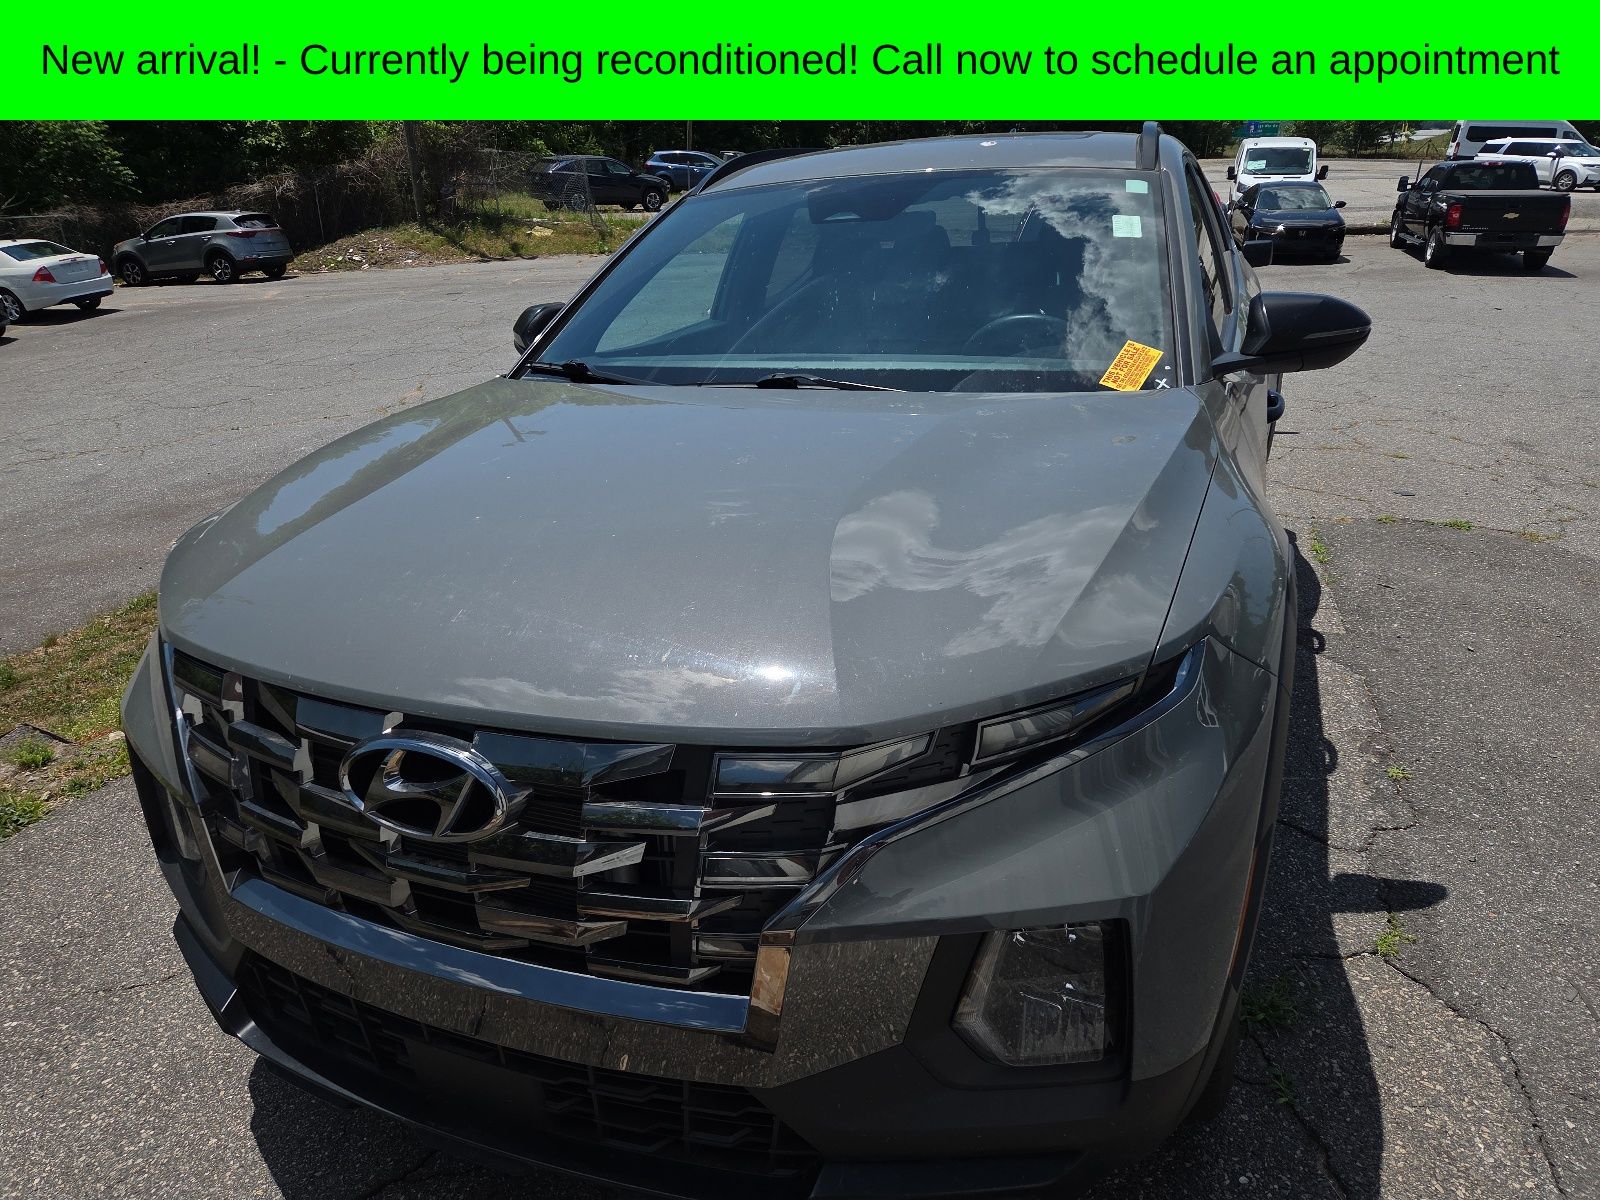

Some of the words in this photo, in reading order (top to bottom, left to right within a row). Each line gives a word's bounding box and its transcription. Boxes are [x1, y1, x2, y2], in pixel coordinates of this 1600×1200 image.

[1103, 371, 1115, 383] THIS
[1111, 348, 1130, 370] VEHICLE
[1110, 371, 1123, 384] NOT
[1118, 360, 1130, 372] FOR
[1126, 346, 1140, 360] SALE
